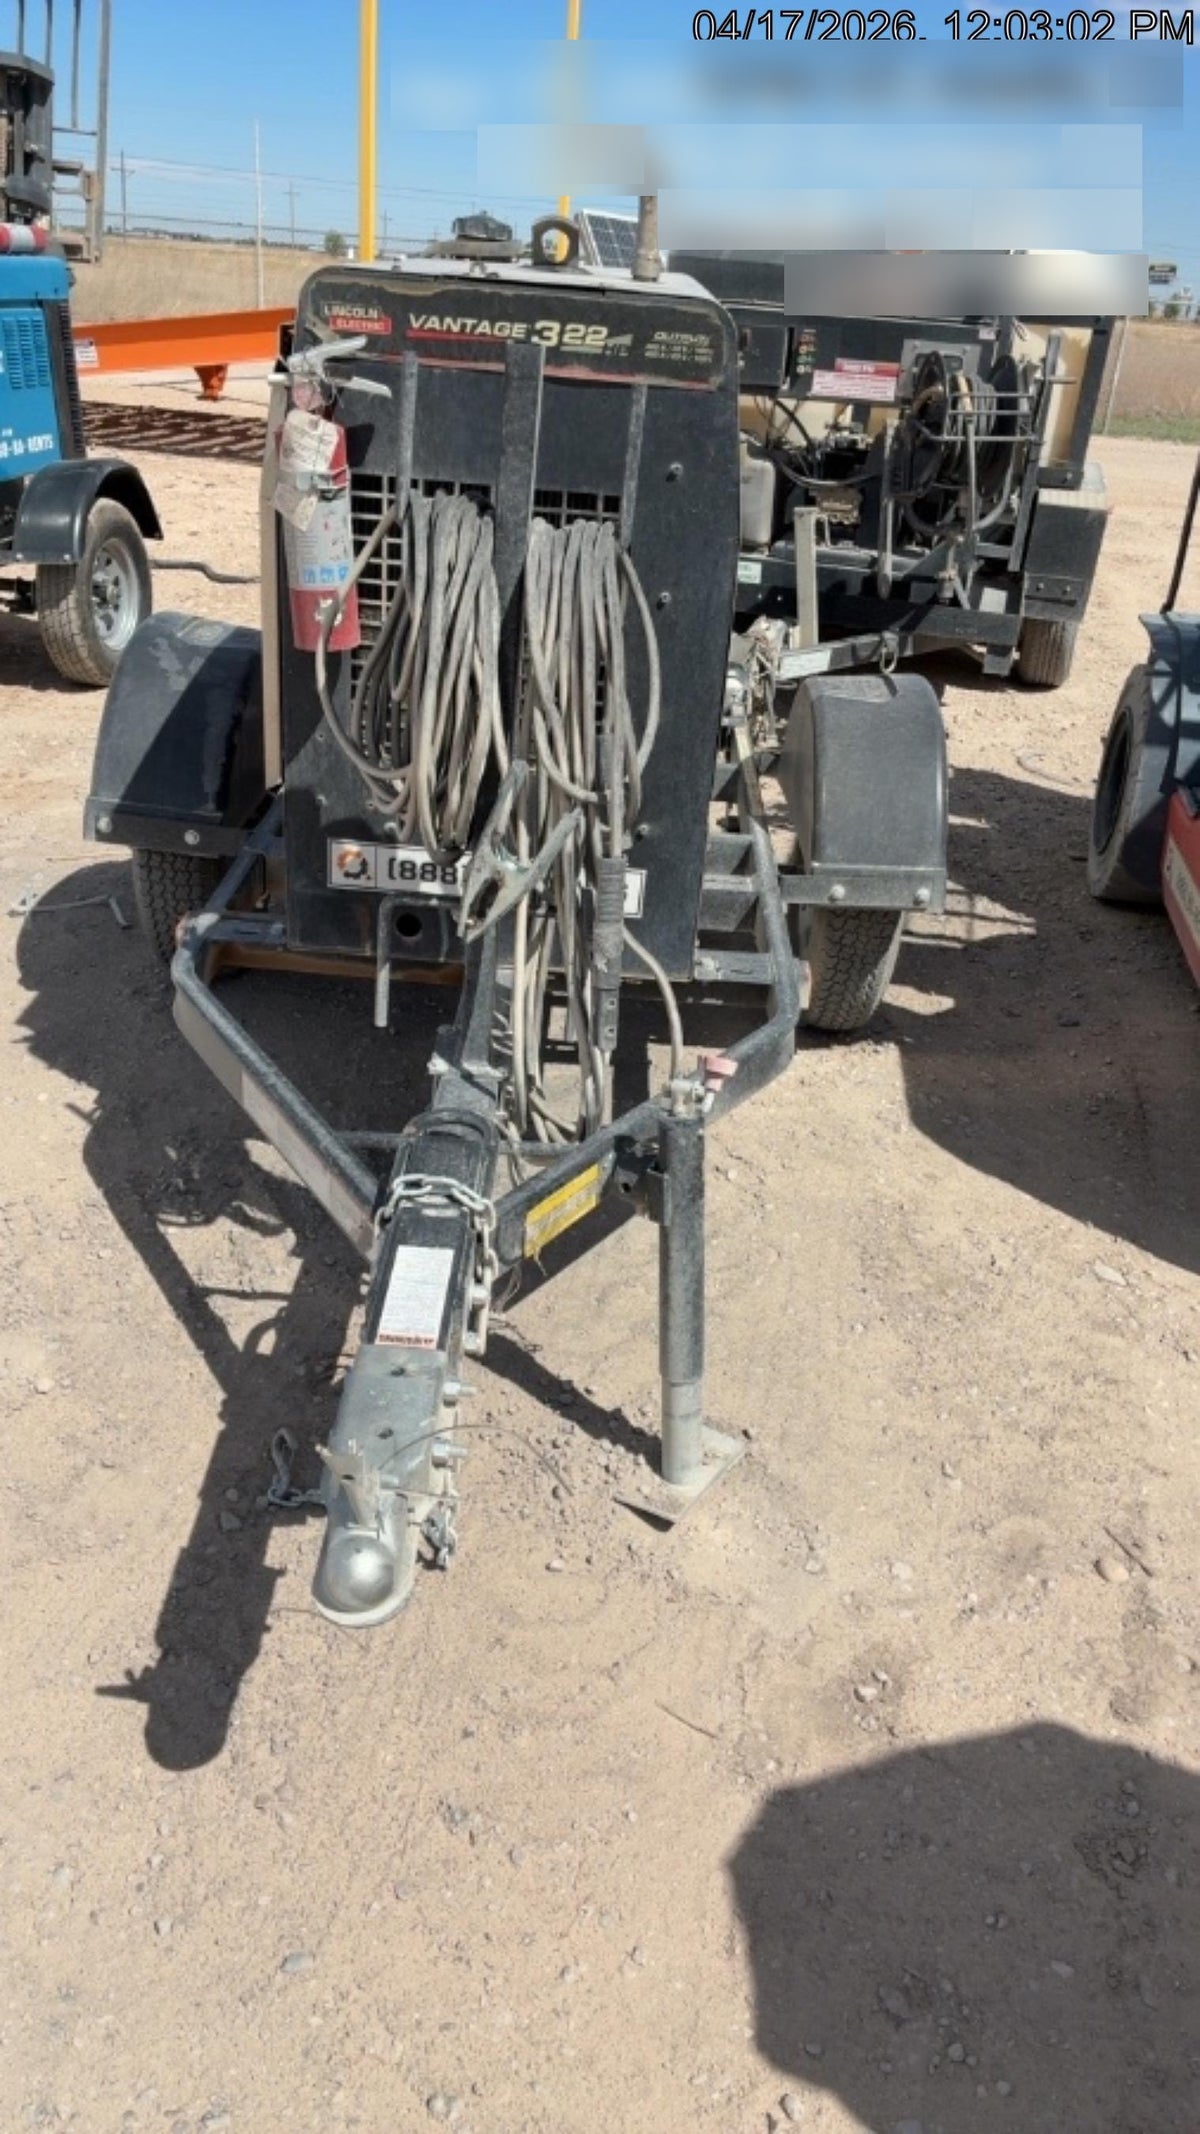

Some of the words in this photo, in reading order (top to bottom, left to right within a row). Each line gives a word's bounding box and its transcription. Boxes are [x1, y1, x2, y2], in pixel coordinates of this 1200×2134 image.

[324, 303, 379, 319] LINCOLN
[335, 318, 386, 331] ELECTRIC
[408, 312, 528, 338] VANTAGE
[530, 320, 608, 347] 322
[388, 856, 466, 886] (888
